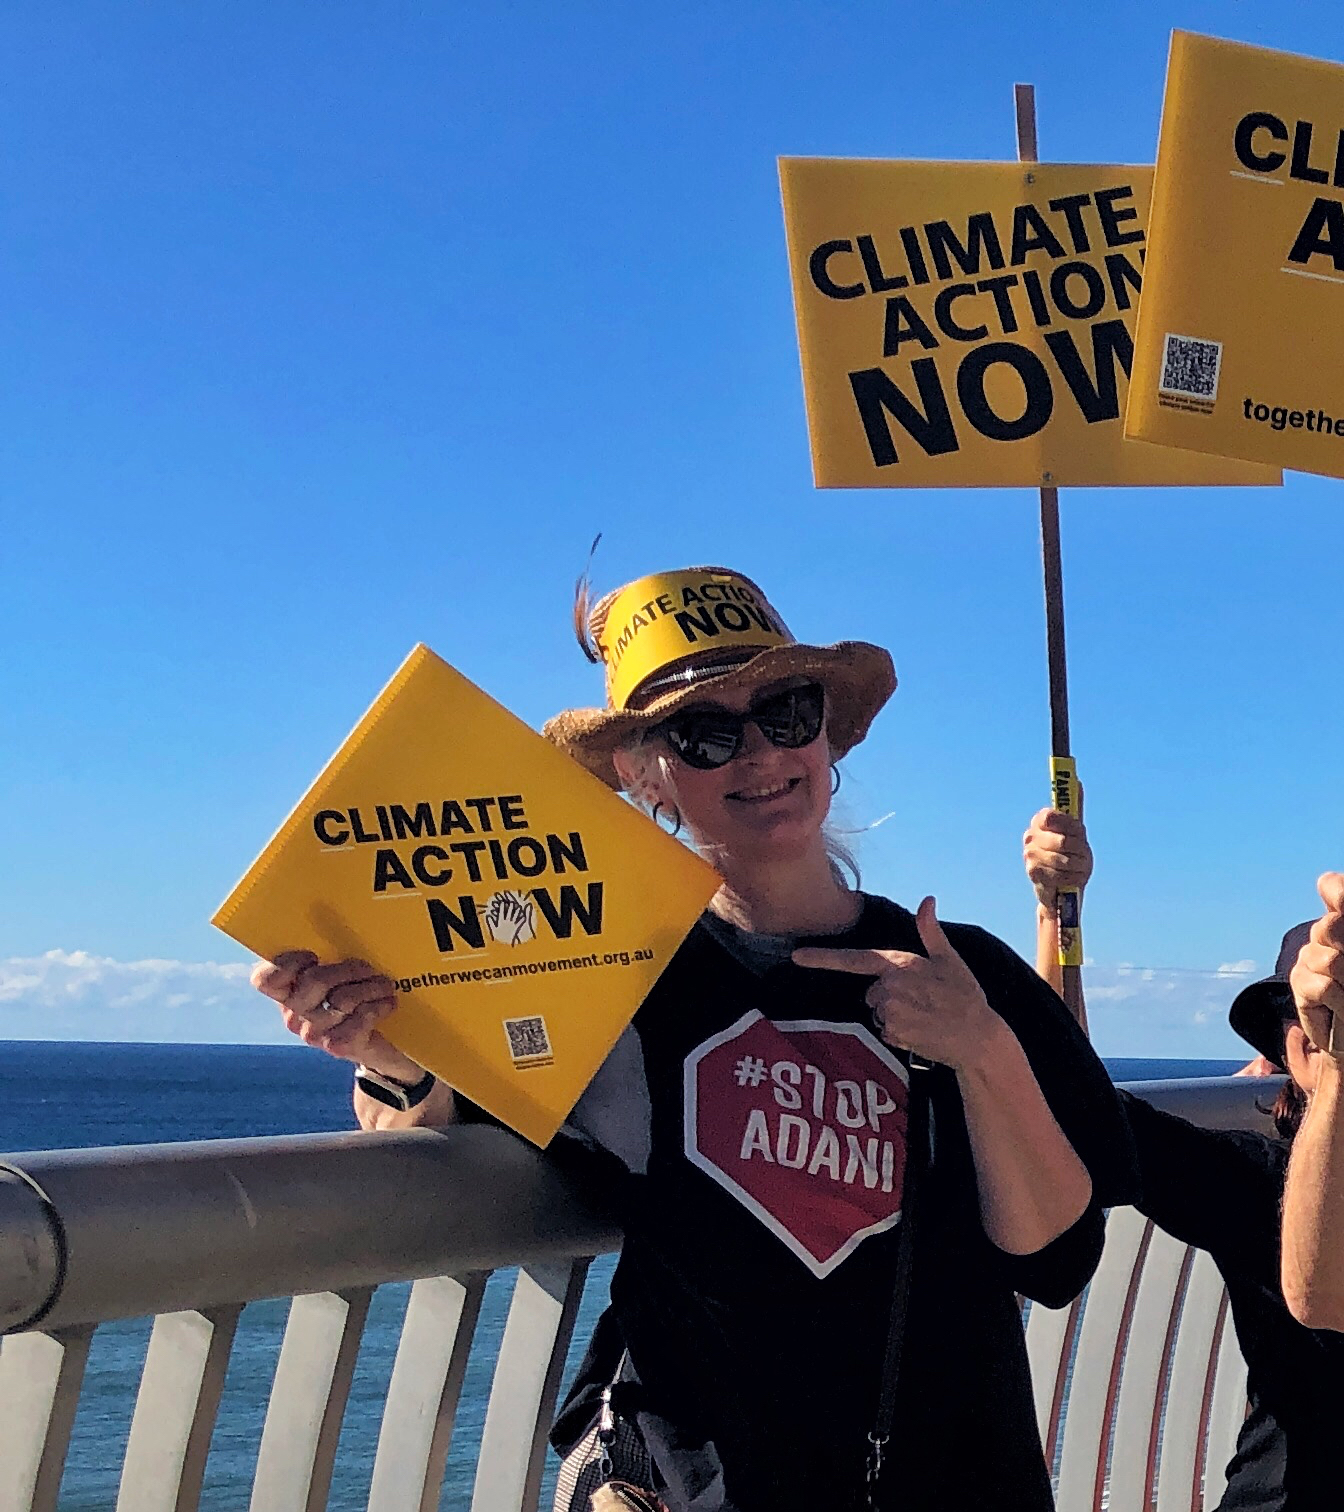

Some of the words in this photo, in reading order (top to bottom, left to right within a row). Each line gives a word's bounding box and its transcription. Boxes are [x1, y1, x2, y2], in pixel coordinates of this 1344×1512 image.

[809, 185, 1146, 300] CLIMATE
[883, 249, 1144, 358] ACTION
[611, 593, 678, 672] LIMATE
[681, 583, 755, 608] ACTIO
[313, 795, 529, 847] CLIMATE
[373, 833, 588, 892] ACTION
[395, 948, 654, 992] getherwecanmovement.org.au
[734, 1055, 897, 1132] #STOP
[740, 1109, 894, 1192] ADANI
